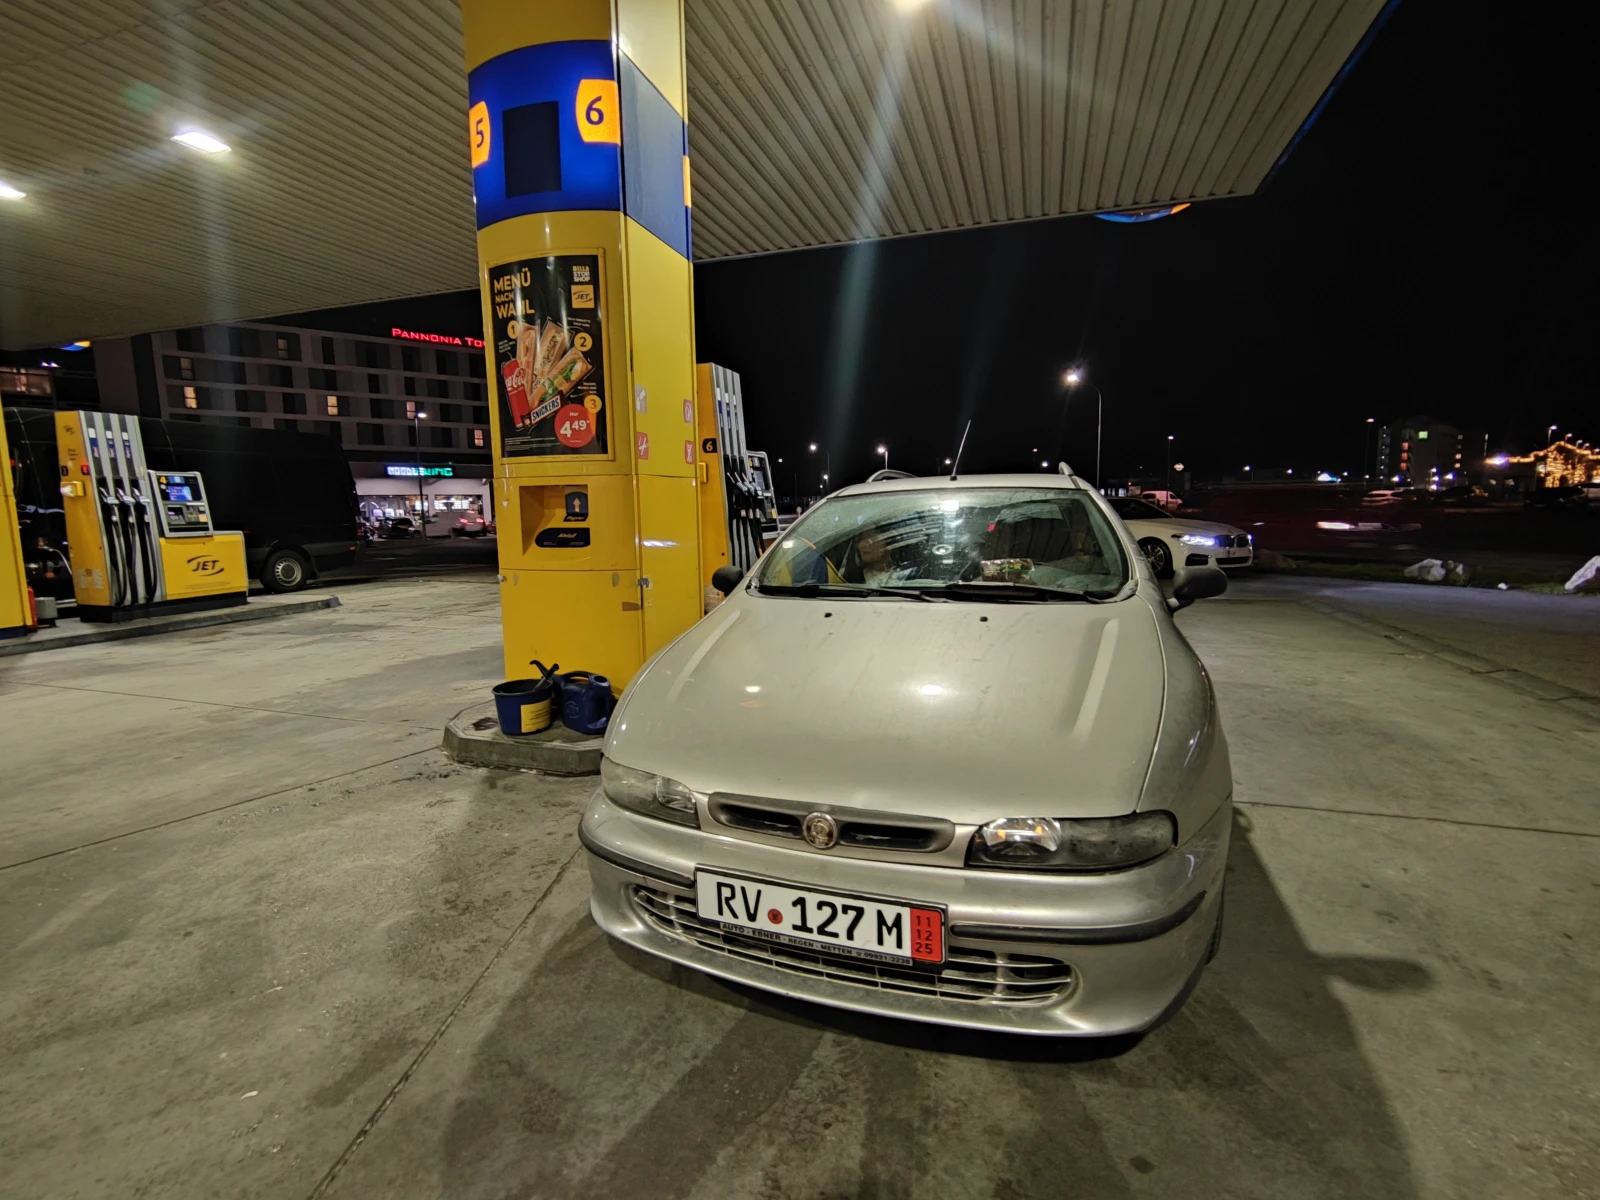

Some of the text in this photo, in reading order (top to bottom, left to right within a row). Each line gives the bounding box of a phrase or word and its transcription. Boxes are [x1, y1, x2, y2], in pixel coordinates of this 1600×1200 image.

[586, 95, 604, 126] 6
[475, 117, 484, 149] 5
[493, 267, 531, 294] MENÜ
[511, 324, 516, 336] 1
[391, 328, 462, 346] PANNONIA
[464, 337, 486, 348] TO
[579, 336, 587, 348] 2
[532, 397, 560, 422] SNICKERS
[589, 398, 597, 410] 3
[706, 441, 714, 451] 6
[192, 560, 220, 572] JET
[716, 881, 903, 950] RV 127 M
[915, 915, 931, 928] 11
[722, 923, 745, 934] AUTO
[752, 930, 781, 941] EBNER
[788, 937, 814, 947] REGEN
[820, 944, 853, 955] METTEN
[916, 929, 932, 941] 12
[915, 942, 933, 954] 25
